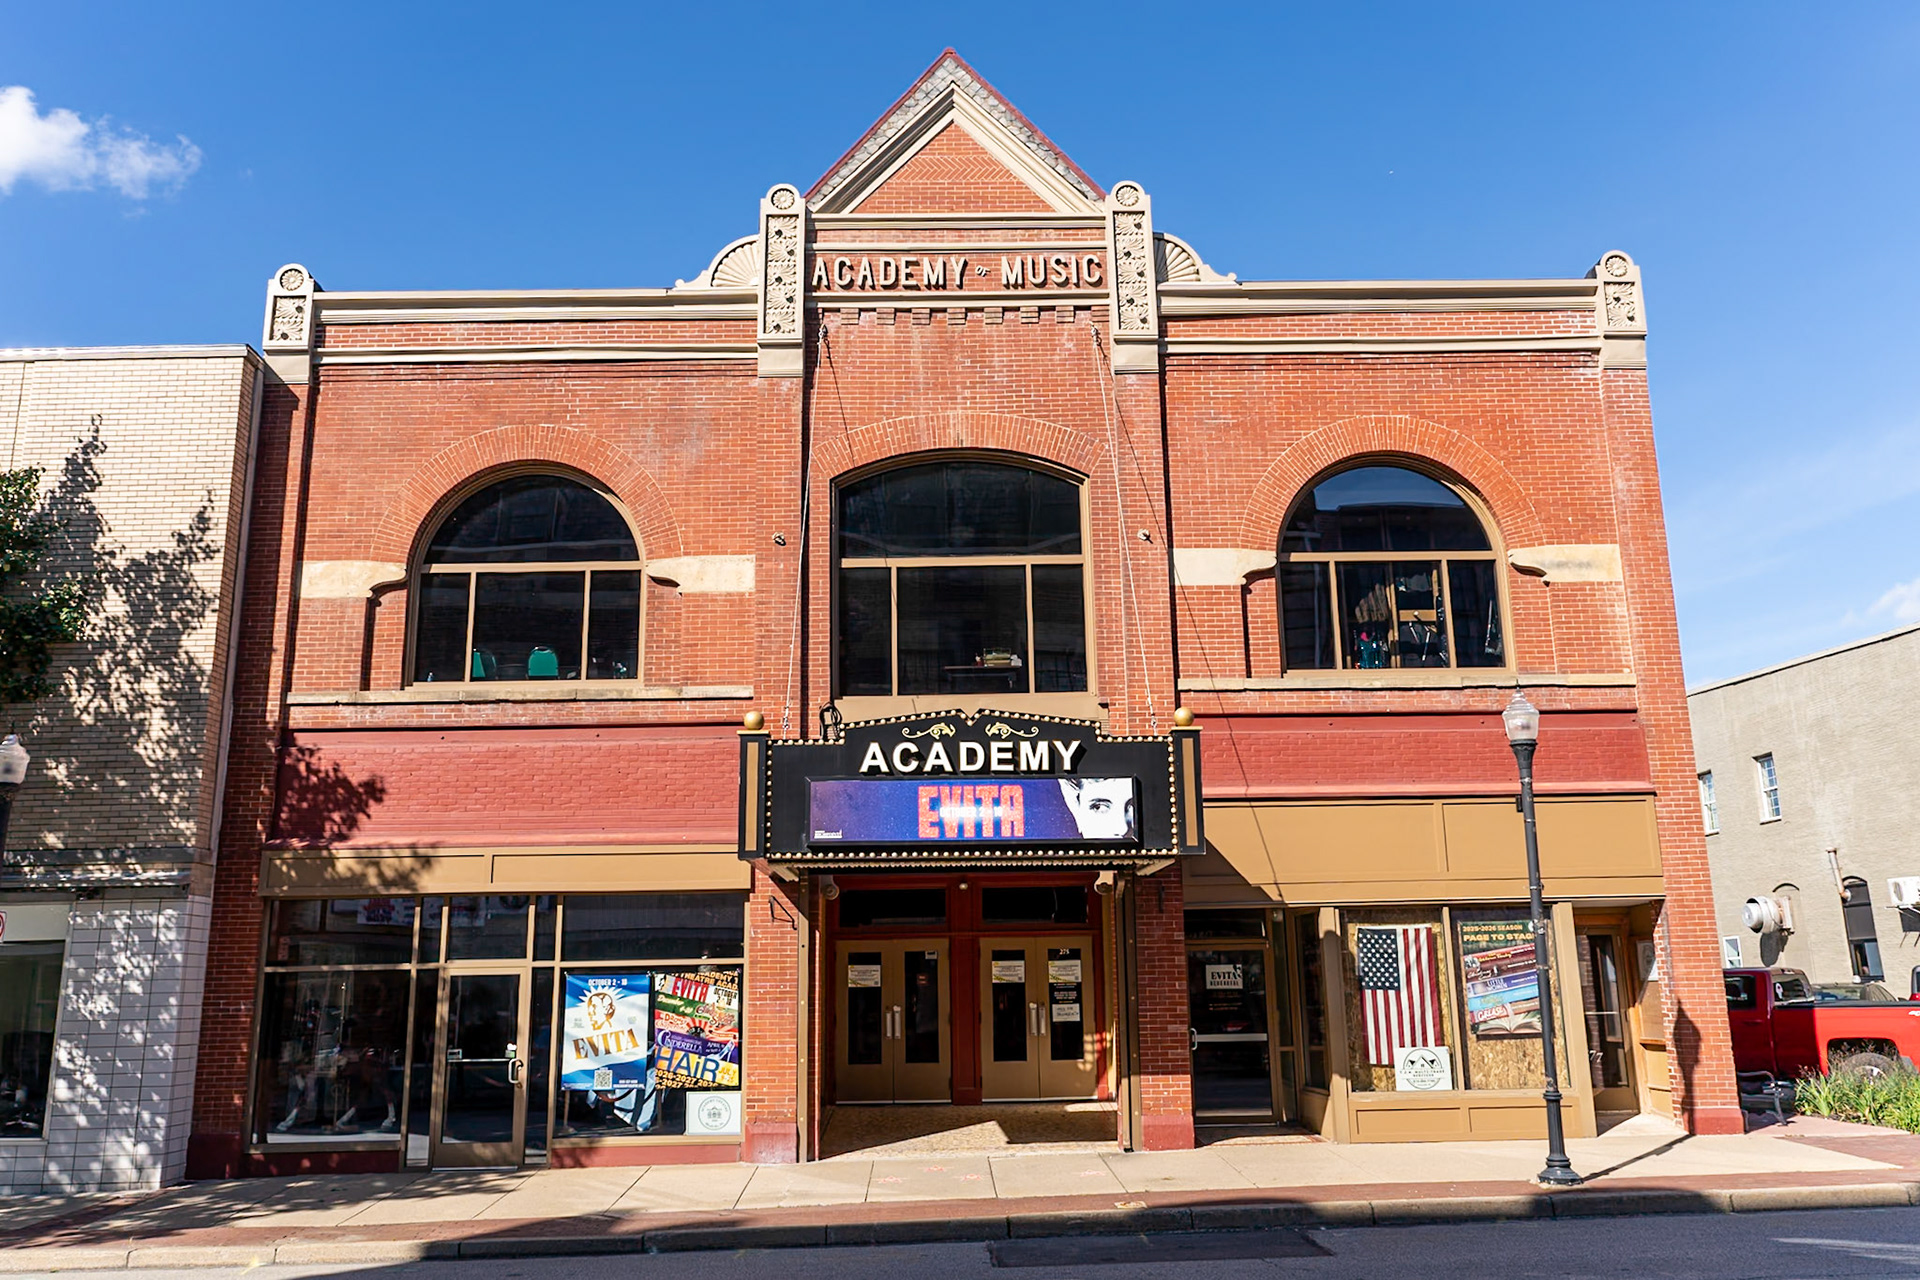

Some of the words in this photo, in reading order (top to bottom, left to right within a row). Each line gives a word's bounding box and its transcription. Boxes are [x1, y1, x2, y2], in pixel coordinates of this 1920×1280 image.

[812, 256, 968, 289] ACADEMY
[976, 265, 990, 277] OF
[1001, 254, 1103, 288] MUSIC
[859, 739, 1082, 773] ACADEMY
[918, 785, 1025, 839] EVITA
[1463, 934, 1490, 942] PAGE
[588, 978, 612, 986] OCTOBER
[612, 978, 617, 986] 2
[1211, 971, 1237, 980] EVITA
[671, 977, 709, 1003] EVITA
[713, 987, 738, 1000] OCTOBER
[572, 1028, 640, 1060] EVITA
